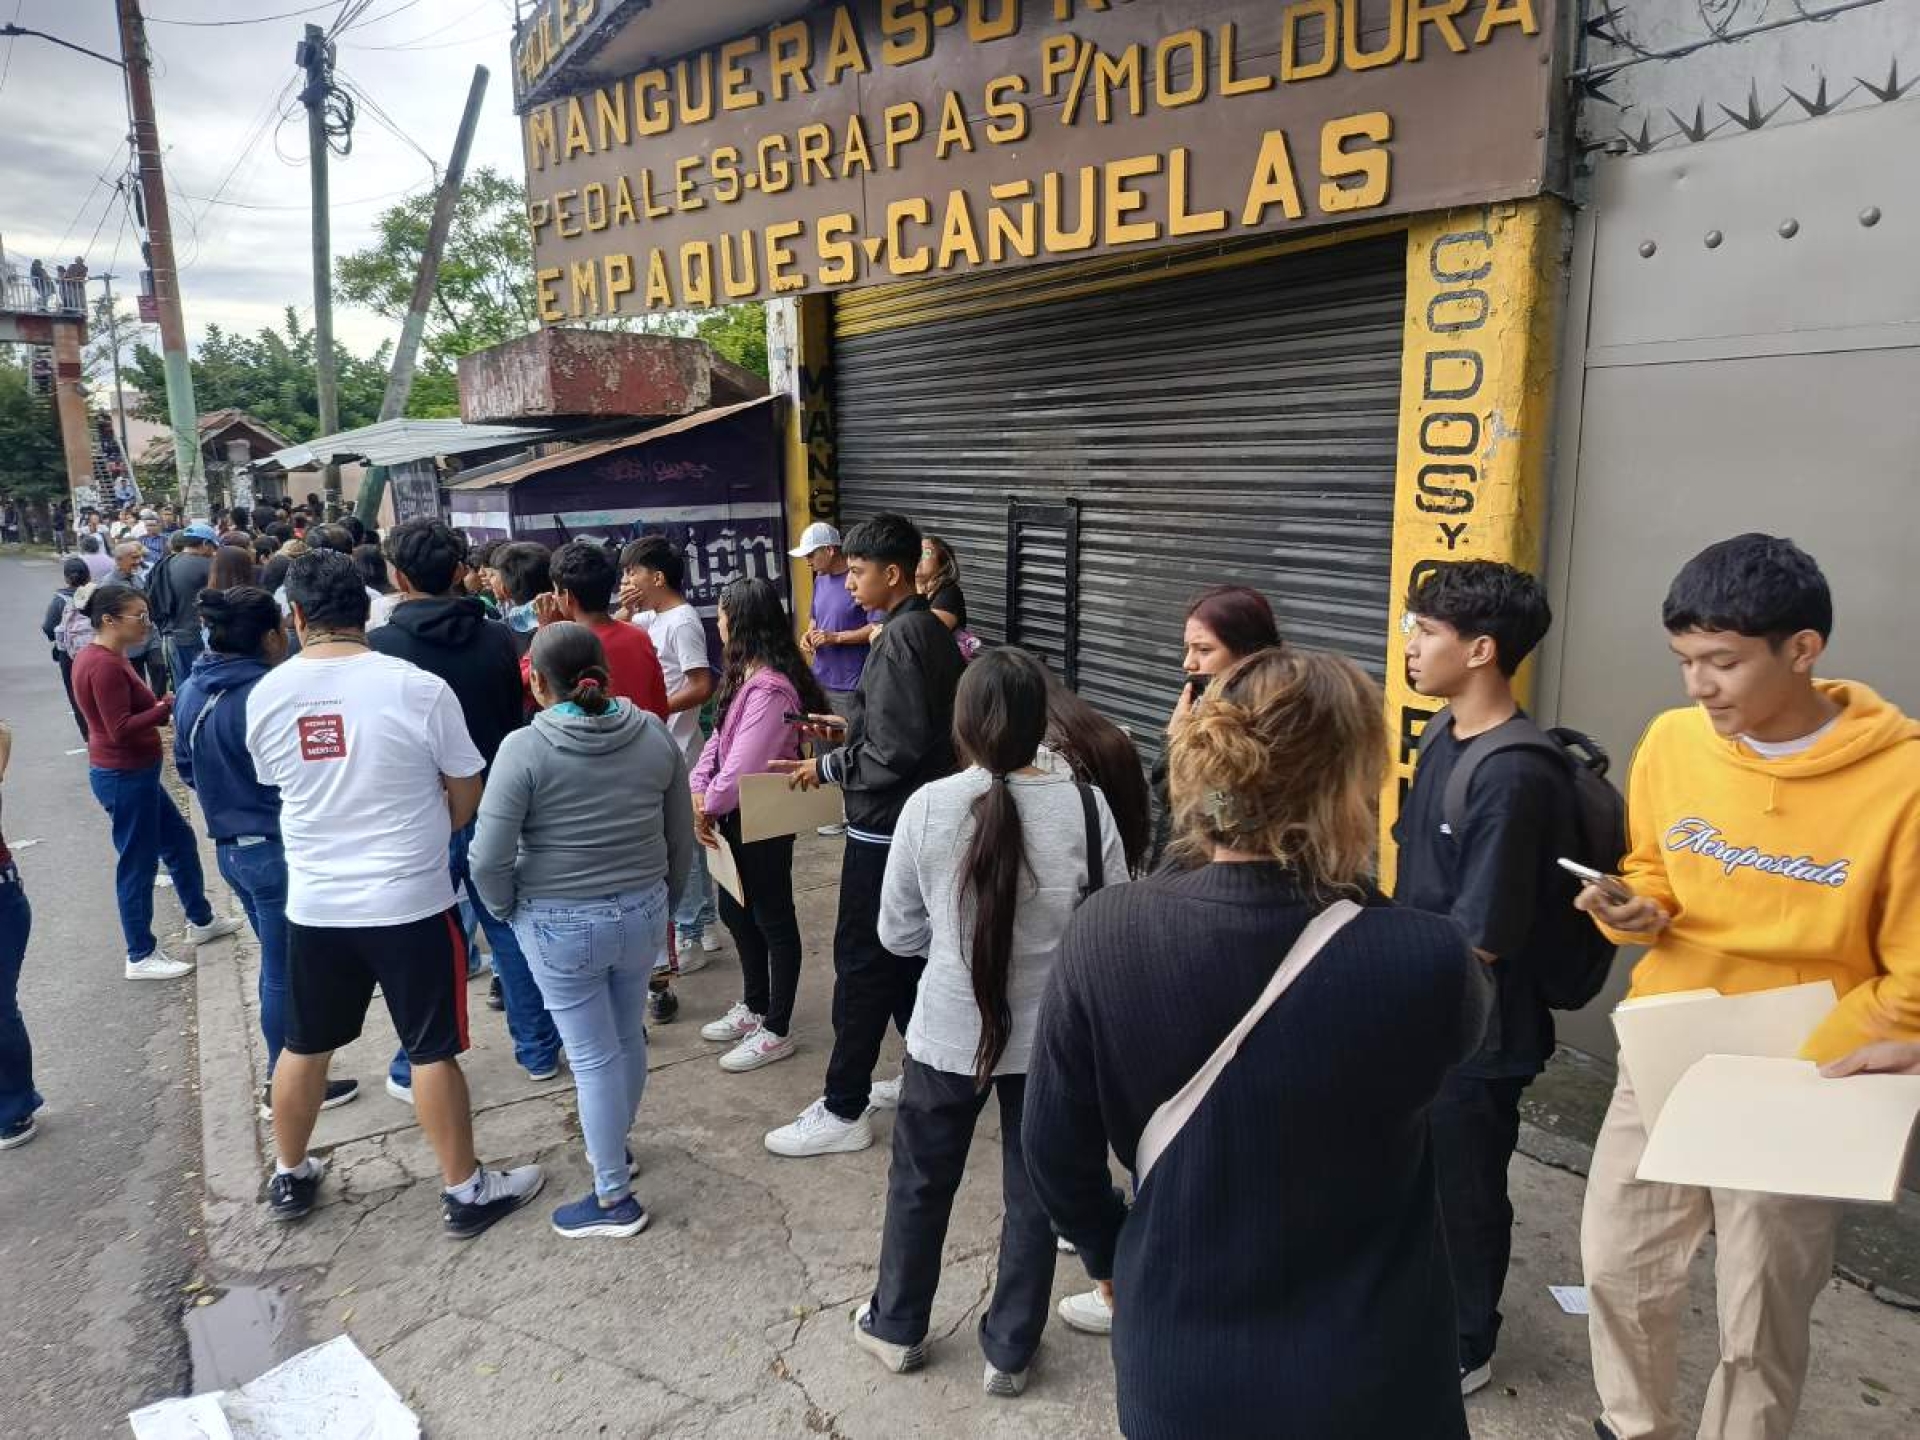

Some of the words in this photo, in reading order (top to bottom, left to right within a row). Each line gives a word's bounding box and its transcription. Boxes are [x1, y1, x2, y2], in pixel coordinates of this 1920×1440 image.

[529, 0, 932, 170] MANGUERAS
[536, 213, 857, 322] EMPAQUES
[887, 111, 1393, 275] CAÑUELAS
[1415, 230, 1494, 515] CODOS
[1665, 817, 1850, 887] Aeropostale
